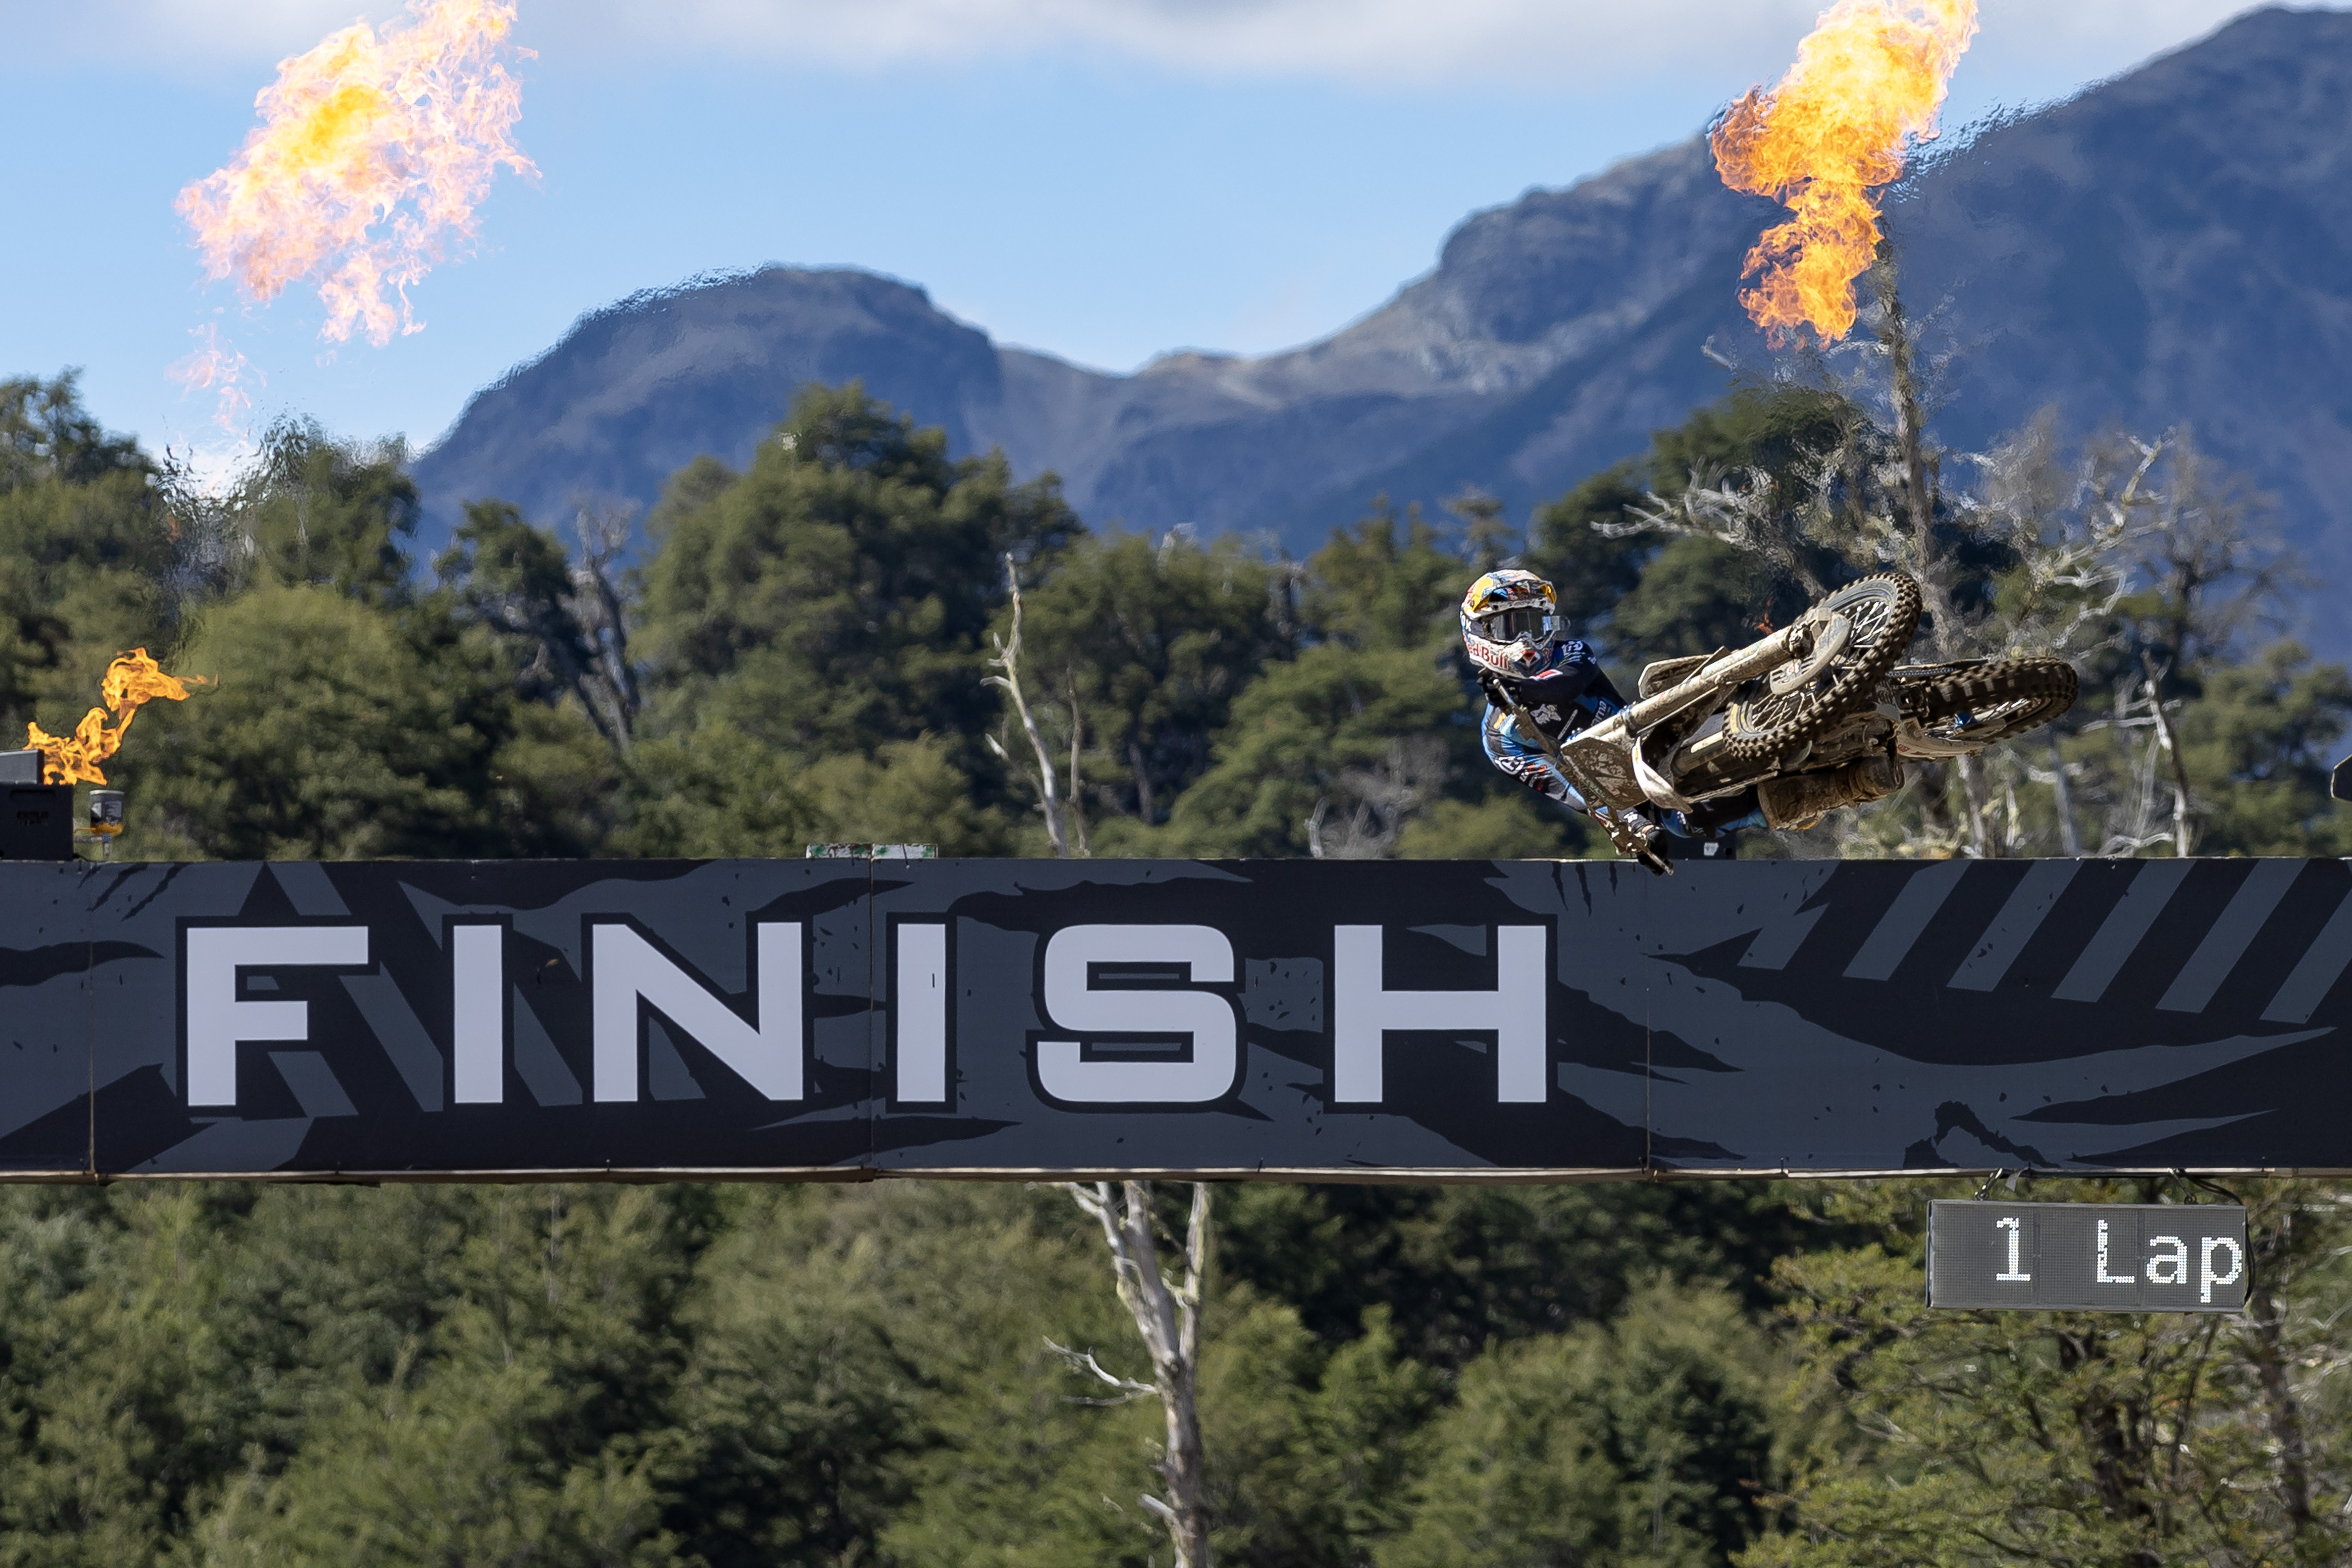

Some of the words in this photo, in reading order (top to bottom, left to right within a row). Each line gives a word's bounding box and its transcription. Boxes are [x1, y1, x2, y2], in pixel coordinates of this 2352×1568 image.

[1481, 646, 1508, 669] Bull
[187, 922, 1546, 1105] FINISH
[1996, 1218, 2031, 1281] 1
[2097, 1220, 2242, 1303] Lap
